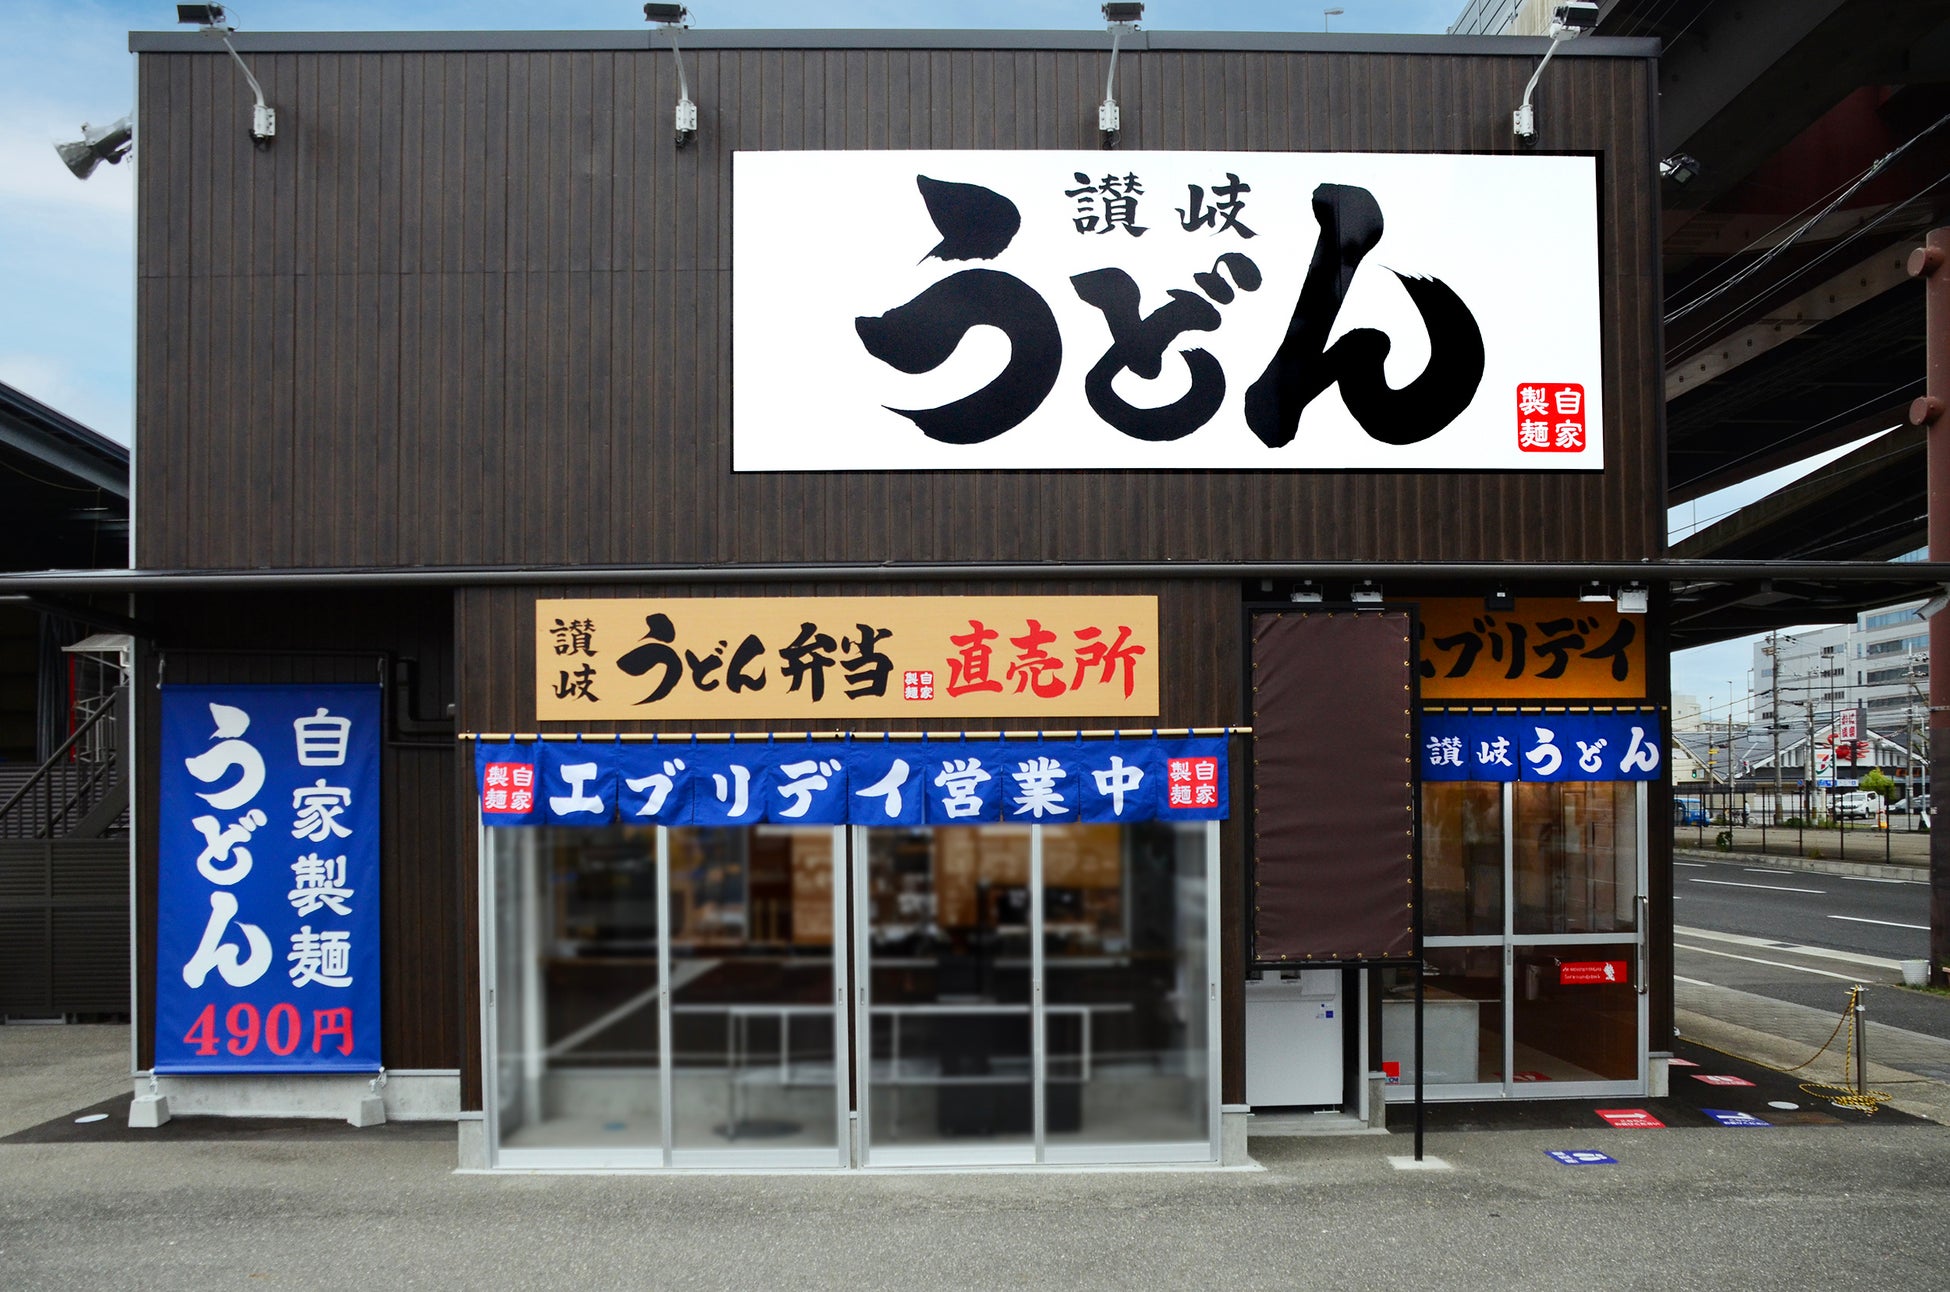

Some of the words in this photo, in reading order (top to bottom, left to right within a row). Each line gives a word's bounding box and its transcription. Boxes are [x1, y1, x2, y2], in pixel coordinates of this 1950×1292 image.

[1064, 171, 1259, 239] 讃岐
[855, 173, 1486, 450] うどん
[550, 618, 600, 702] 讃岐
[616, 612, 894, 706] うどん弁当
[945, 619, 1146, 700] 直売所
[1420, 615, 1636, 682] ブリデイ
[549, 755, 1145, 819] エブリデイ営業中
[1425, 726, 1660, 777] 讃岐うどん
[182, 702, 273, 989] うどん
[287, 706, 355, 989] 自家製麺
[183, 1002, 355, 1056] 490円
